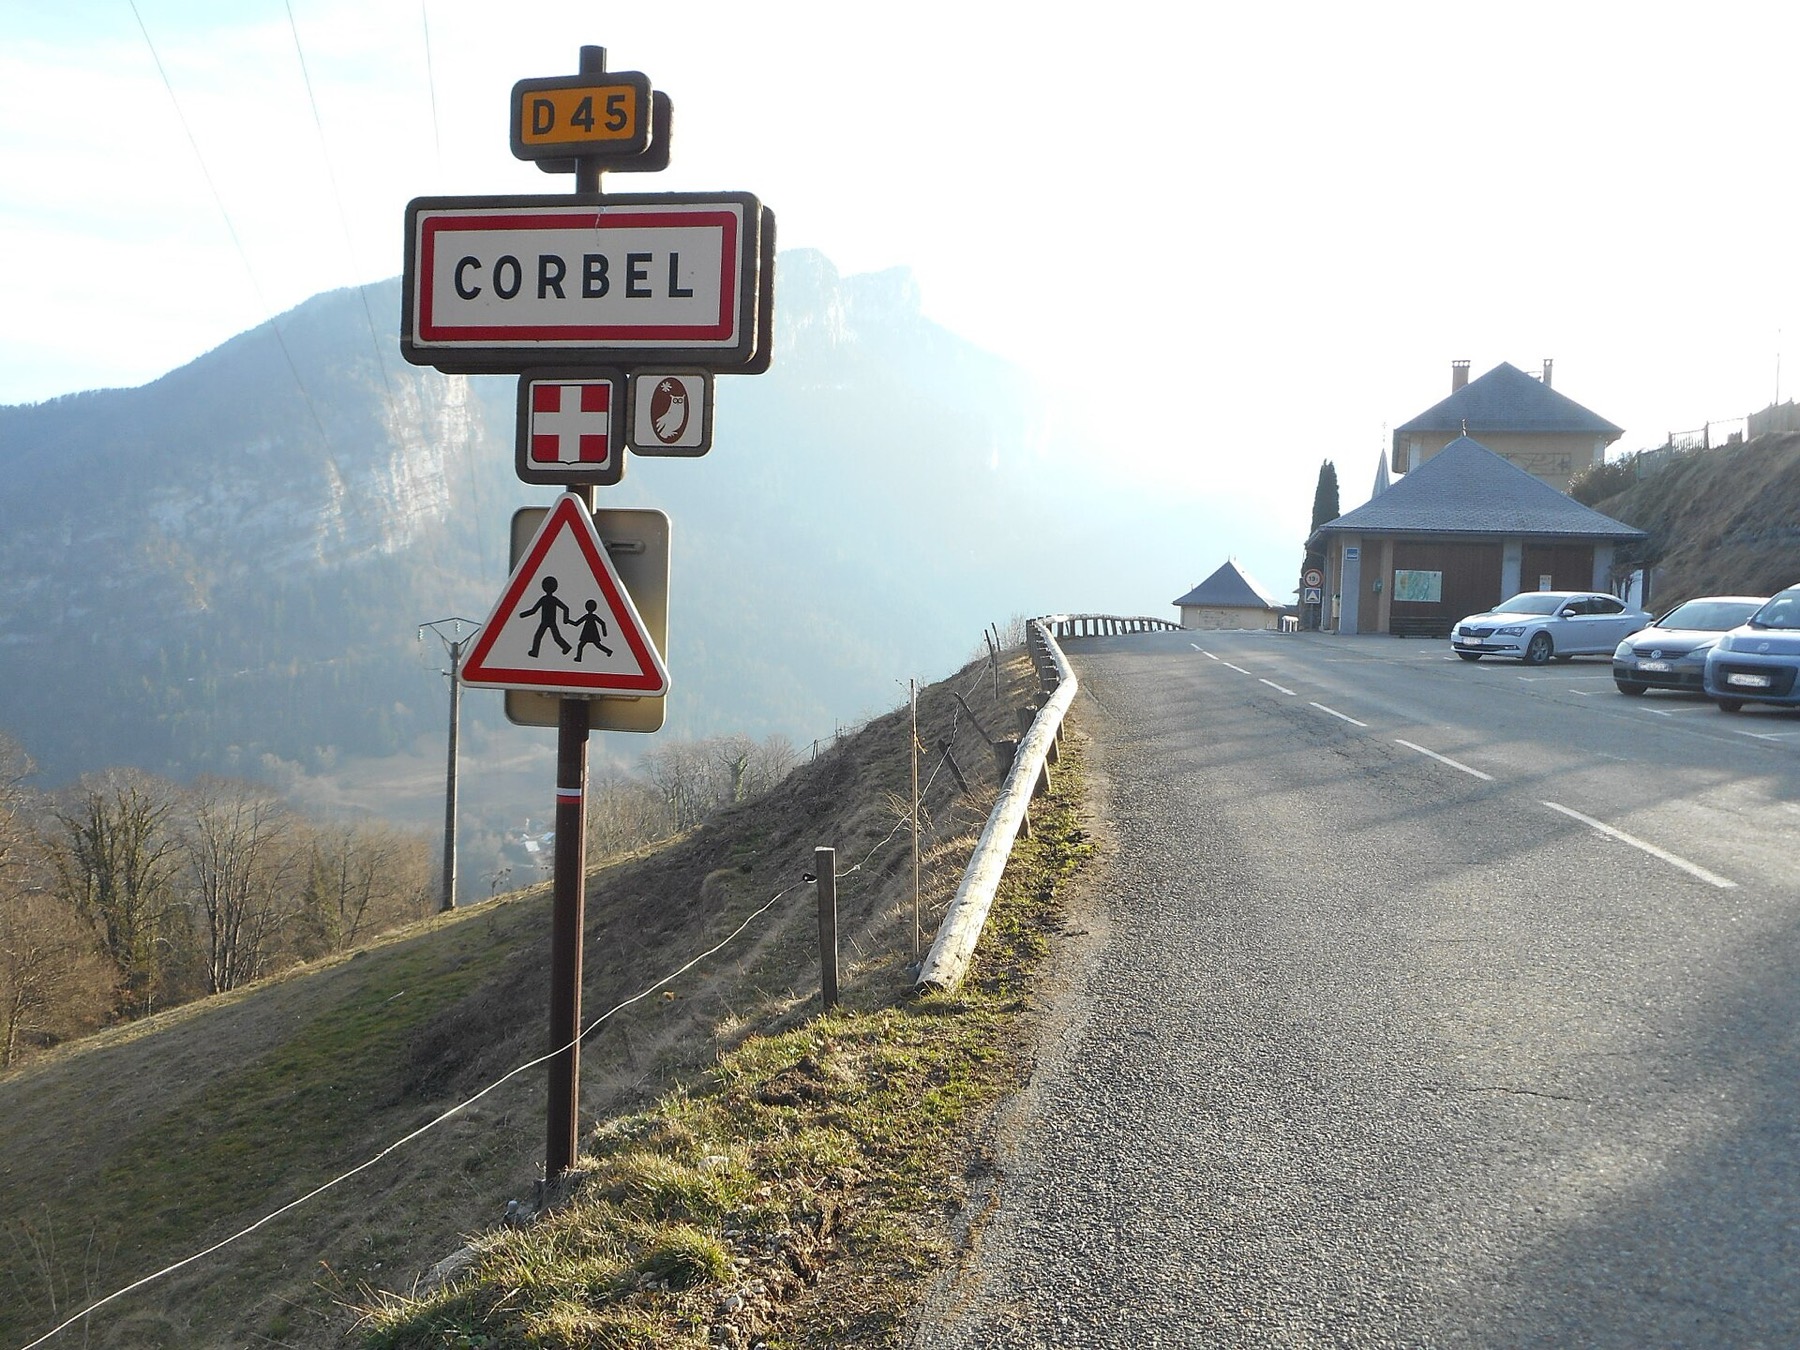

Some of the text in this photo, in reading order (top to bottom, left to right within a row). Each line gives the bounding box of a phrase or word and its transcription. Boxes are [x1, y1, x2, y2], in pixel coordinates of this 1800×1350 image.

[532, 94, 628, 136] D 45
[454, 252, 694, 301] CORBEL
